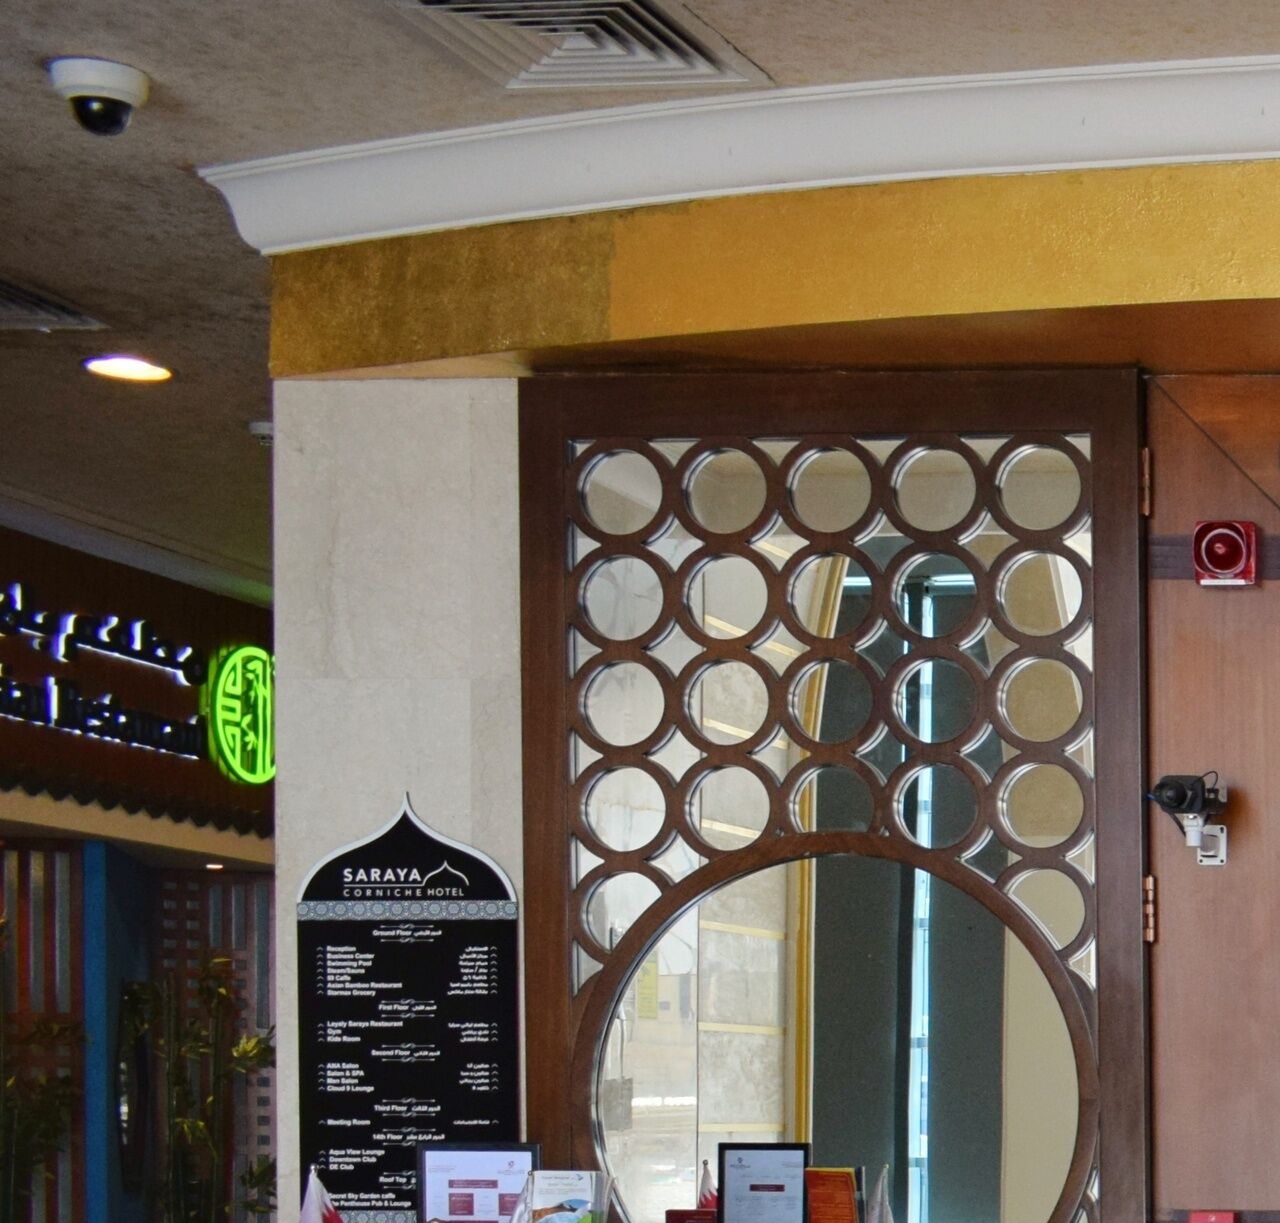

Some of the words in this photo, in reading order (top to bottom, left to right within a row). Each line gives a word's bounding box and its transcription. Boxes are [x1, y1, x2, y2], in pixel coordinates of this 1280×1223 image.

[343, 868, 422, 882] SARAYA
[343, 888, 422, 897] CORNICHE
[428, 887, 465, 897] HOTEL
[396, 928, 412, 936] Floor
